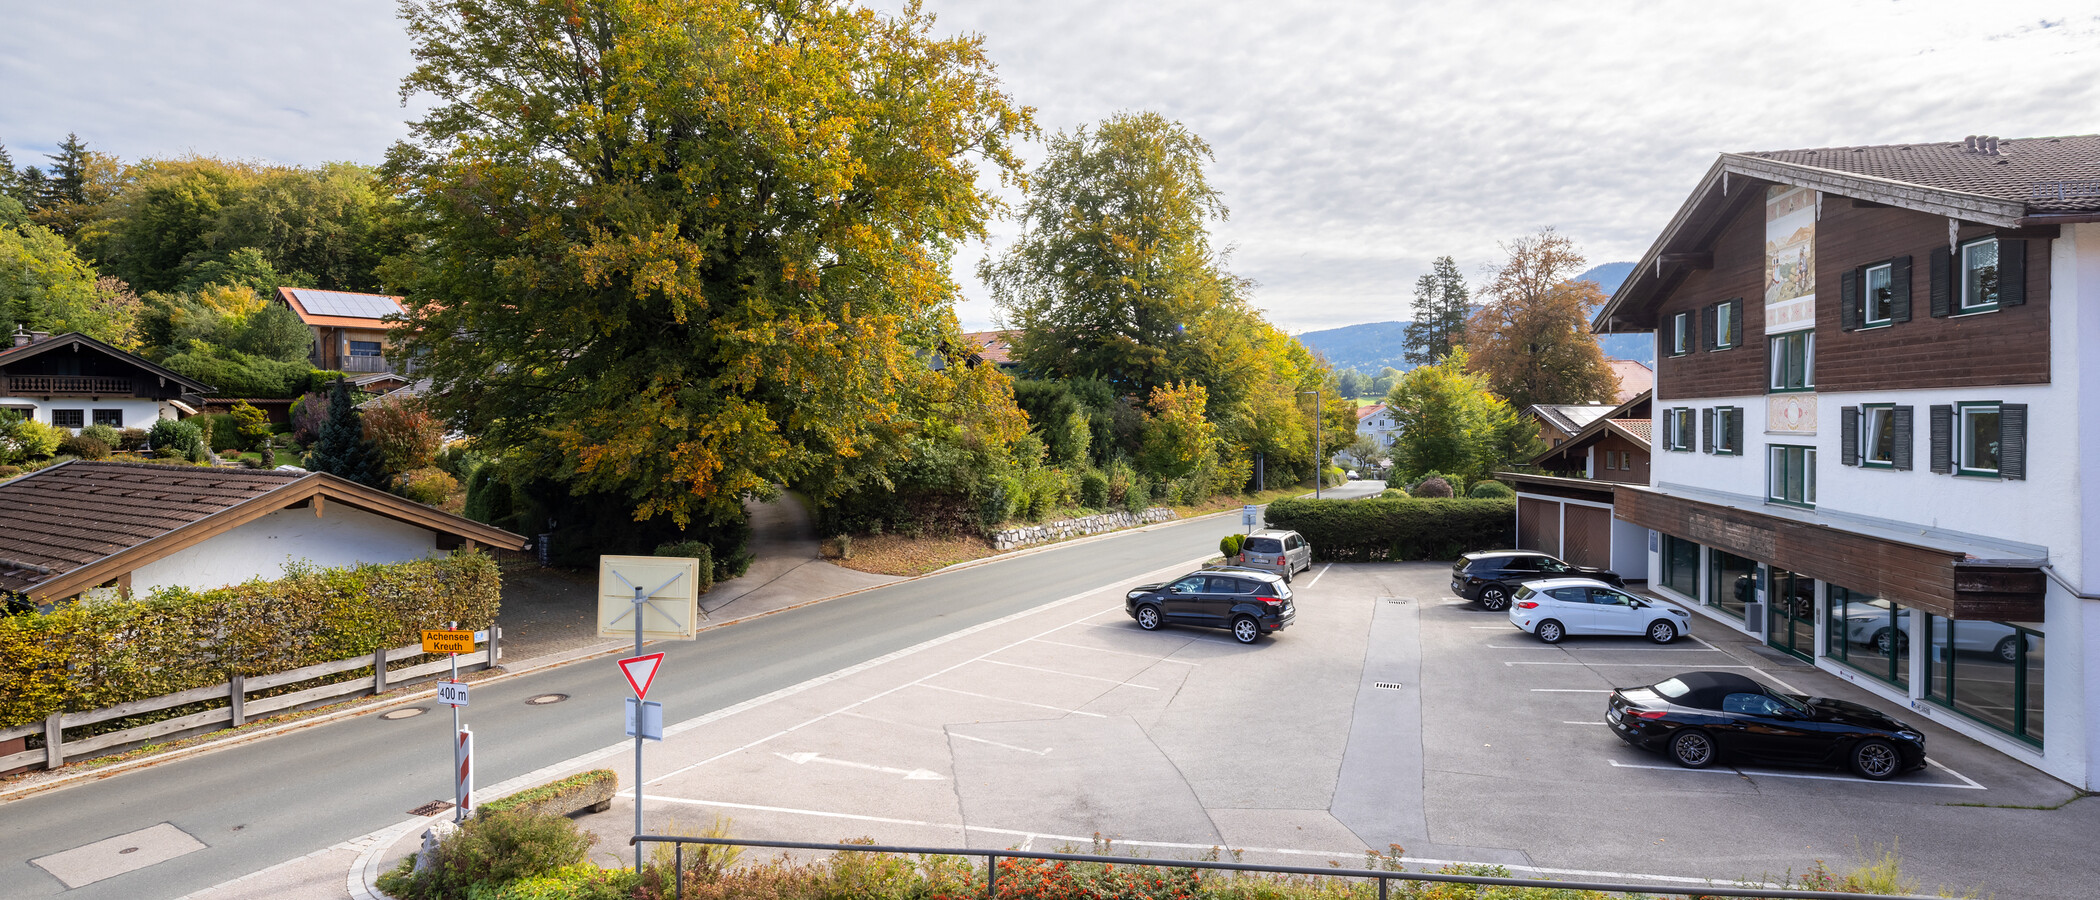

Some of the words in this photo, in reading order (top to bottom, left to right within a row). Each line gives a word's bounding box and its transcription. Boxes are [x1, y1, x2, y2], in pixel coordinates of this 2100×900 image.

[426, 632, 469, 641] Achensee
[433, 642, 463, 651] Kreuth
[440, 687, 456, 700] 400
[457, 691, 466, 701] m
